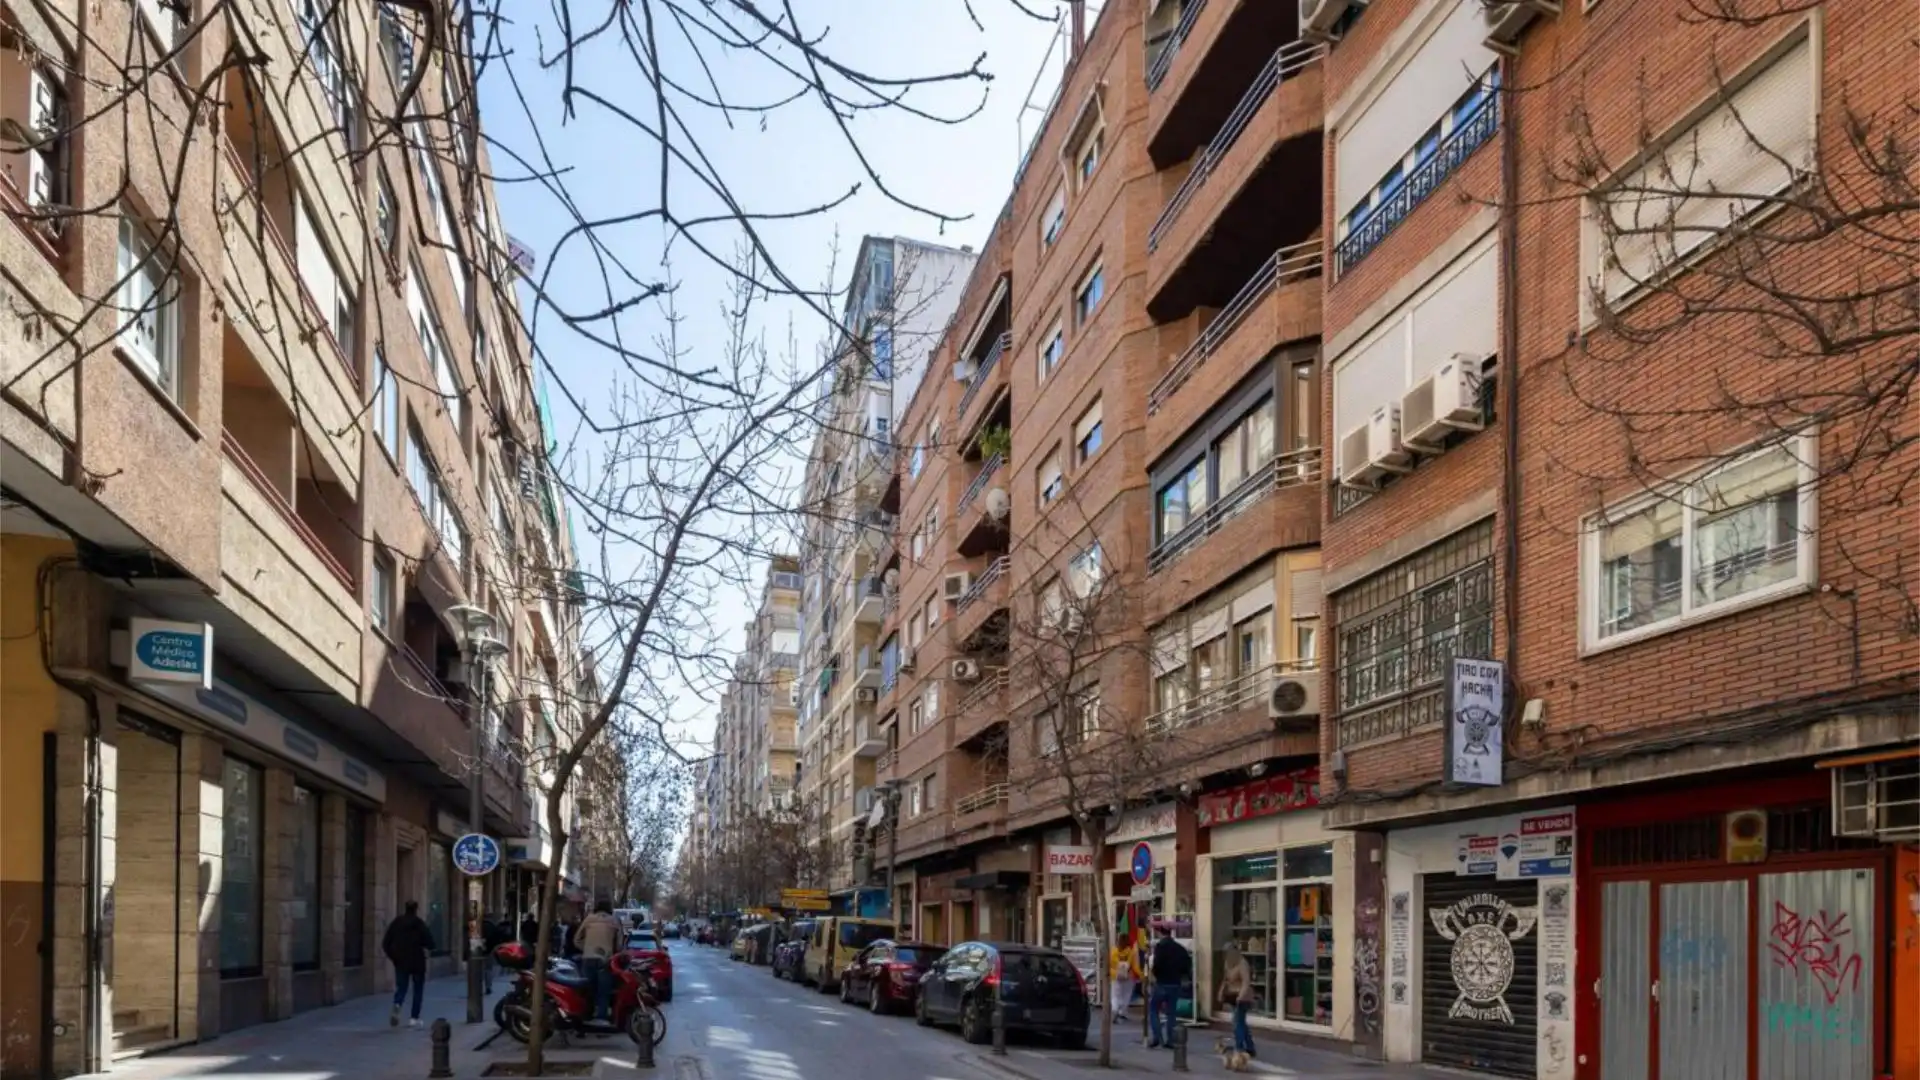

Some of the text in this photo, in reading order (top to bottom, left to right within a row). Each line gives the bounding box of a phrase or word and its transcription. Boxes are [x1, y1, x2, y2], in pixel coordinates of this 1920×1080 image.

[151, 635, 193, 647] Centro
[1457, 663, 1499, 684] TIRO CON
[1462, 681, 1493, 704] HACHA
[1523, 817, 1570, 831] SE VENDE
[1050, 854, 1094, 866] BAZAR
[1467, 911, 1495, 925] AXE
